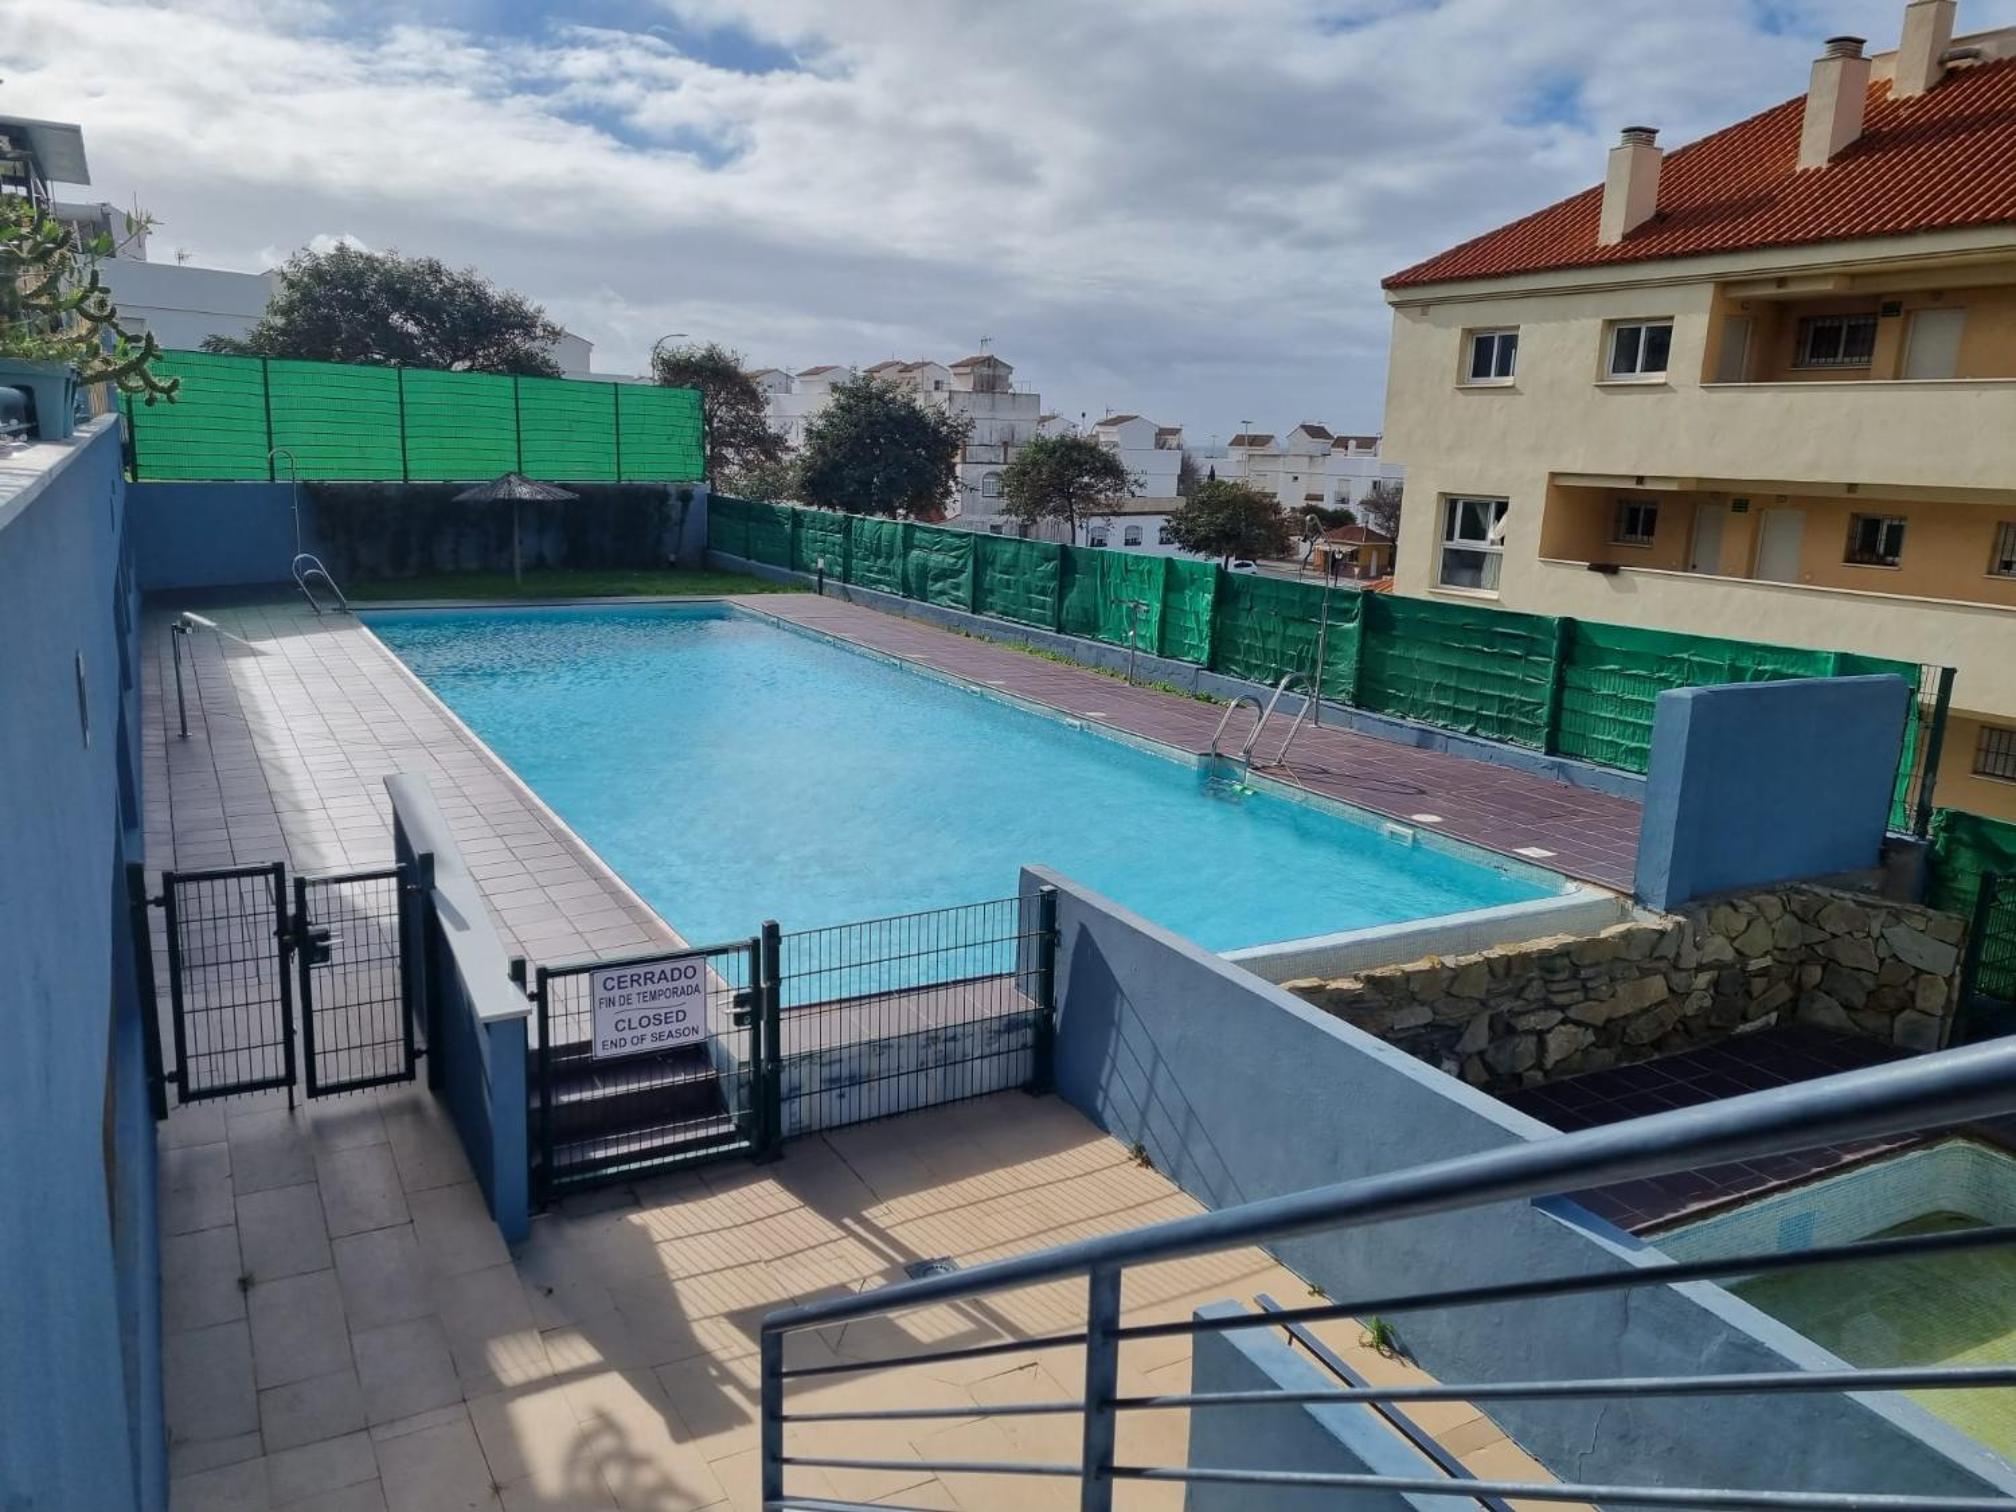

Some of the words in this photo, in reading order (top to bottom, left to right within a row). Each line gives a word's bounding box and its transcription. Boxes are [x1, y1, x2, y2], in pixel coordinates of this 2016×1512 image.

[602, 965, 697, 992] CERRADO
[598, 996, 616, 1009] FIN
[618, 993, 633, 1006] DE
[636, 983, 702, 1005] TEMPORADA
[614, 1009, 687, 1033] CLOSED
[601, 1037, 627, 1051] END
[630, 1034, 647, 1046] OF
[650, 1025, 700, 1043] SEASON
